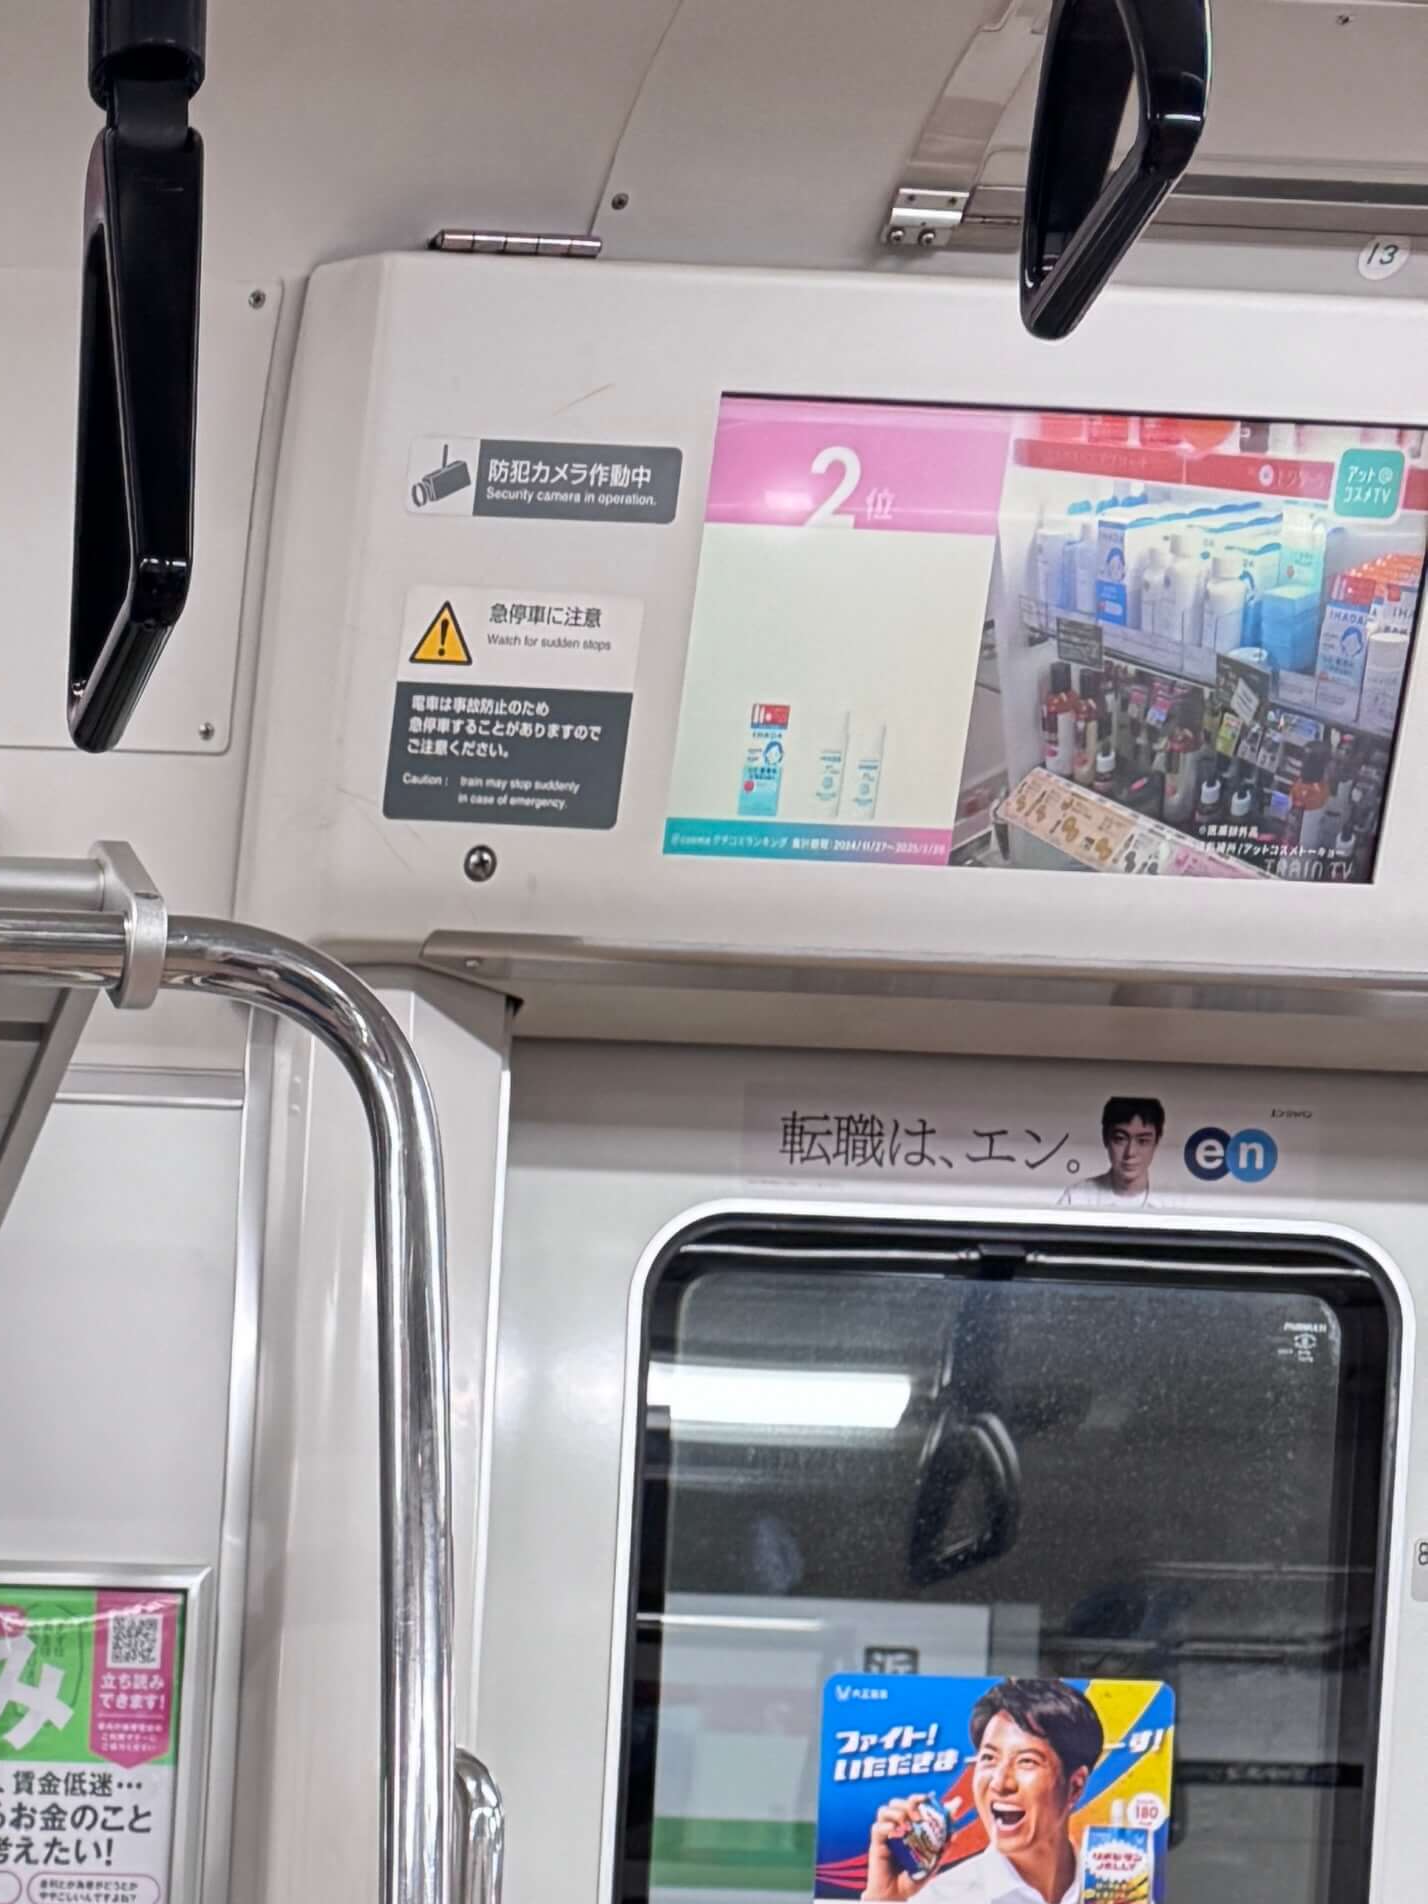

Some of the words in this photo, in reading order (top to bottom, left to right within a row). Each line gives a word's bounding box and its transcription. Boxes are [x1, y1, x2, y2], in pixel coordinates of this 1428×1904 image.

[1366, 242, 1398, 266] 13
[488, 459, 652, 489] 防犯カメラ作動中
[486, 486, 533, 503] Security
[537, 490, 581, 503] camera
[598, 492, 657, 509] operation.
[803, 445, 862, 530] 2
[489, 602, 602, 628] 急停車に注意
[487, 633, 521, 647] Watch
[523, 635, 538, 647] for
[541, 636, 580, 650] sudden
[583, 638, 612, 652] stops
[411, 694, 550, 717] 電車は事故防止のため
[408, 715, 603, 742] 急停車することがありますので
[407, 738, 510, 759] ご注意ください。
[402, 771, 442, 786] Caution
[778, 1110, 1081, 1175] 転職は、エン。
[1191, 1135, 1268, 1172] en
[834, 1723, 940, 1755] ファイト!
